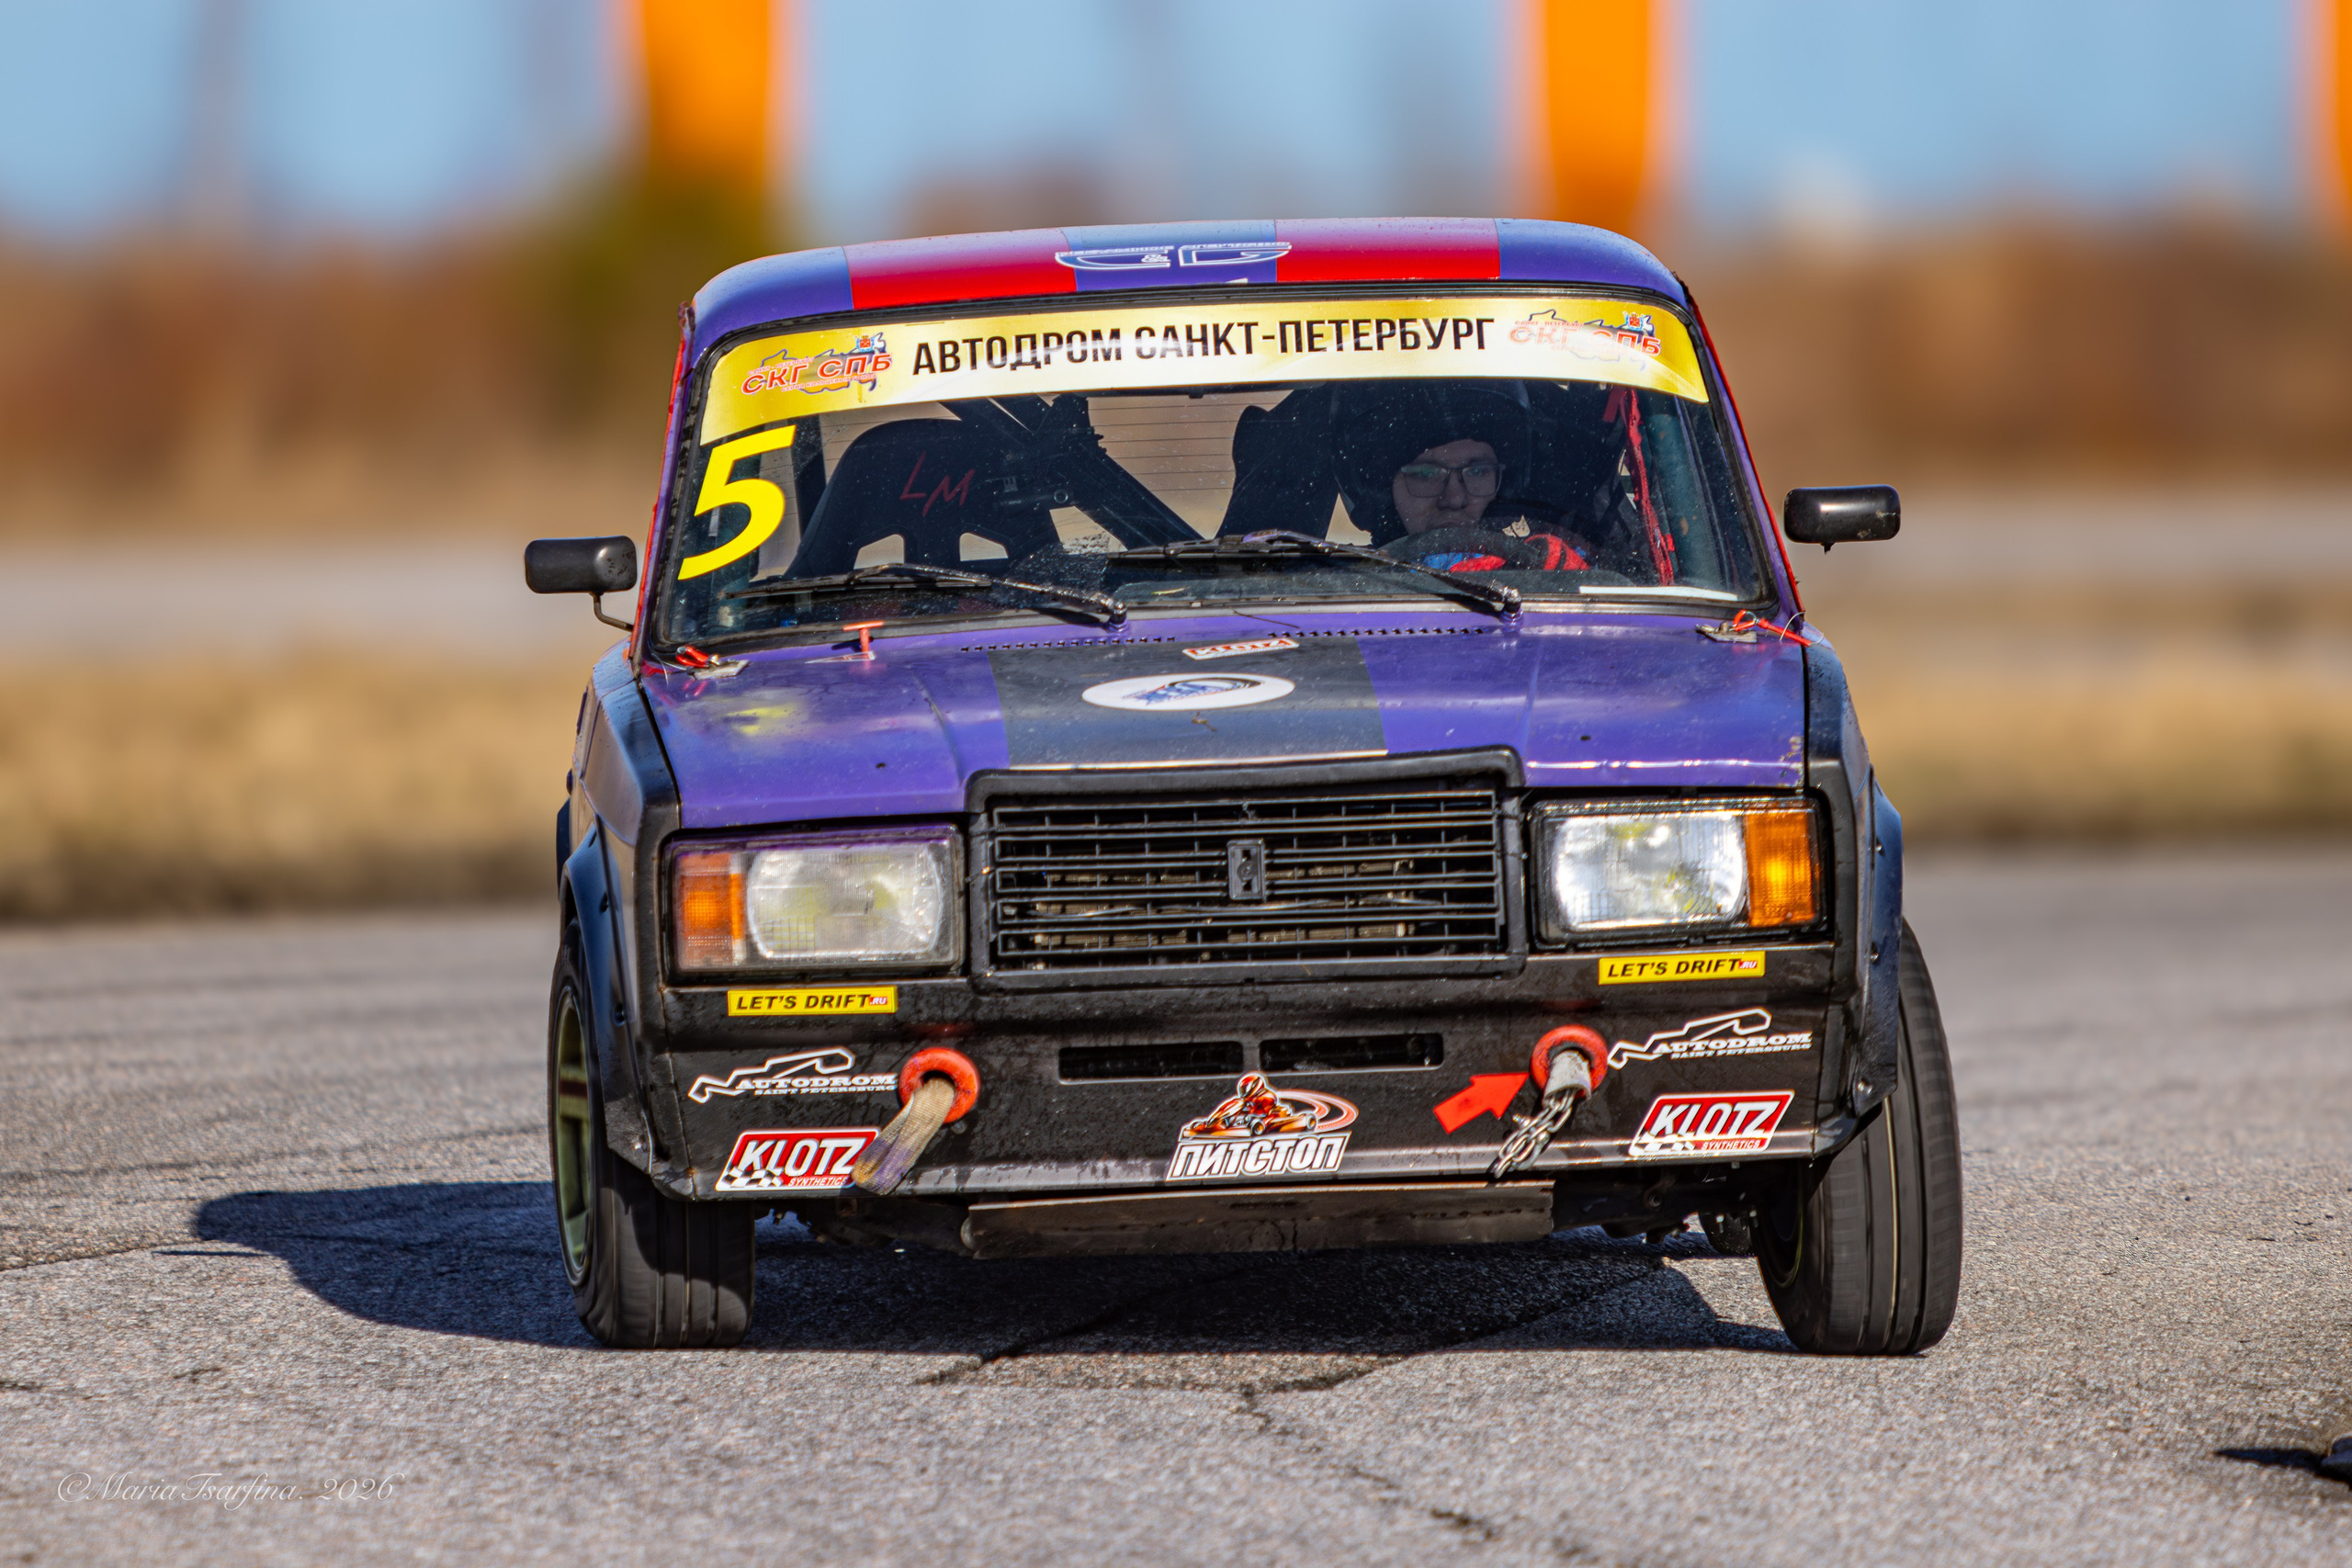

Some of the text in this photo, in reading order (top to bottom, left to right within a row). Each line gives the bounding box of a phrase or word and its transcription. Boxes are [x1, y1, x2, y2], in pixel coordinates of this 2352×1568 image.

[911, 317, 1495, 376] АВТОДРОМ САНКТ-ПЕТЕРБУРГ
[1508, 326, 1578, 344] СКГ
[1589, 329, 1661, 356] СПБ
[741, 353, 892, 395] СКГ СПБ
[677, 424, 797, 581] 5
[1607, 963, 1668, 977] LET'S
[736, 994, 797, 1010] LET'S
[1652, 1031, 1813, 1054] AUTODROM
[1670, 1043, 1812, 1059] SAINT PETERSBURG
[735, 1073, 898, 1089] AUTODROM
[754, 1084, 898, 1096] SAINT PETERSBURG
[1650, 1100, 1781, 1139] KLOTZ
[737, 1136, 868, 1178] KLOTZ
[1169, 1134, 1350, 1179] ПИТСТОП
[1701, 1139, 1761, 1150] SYNTHETICS
